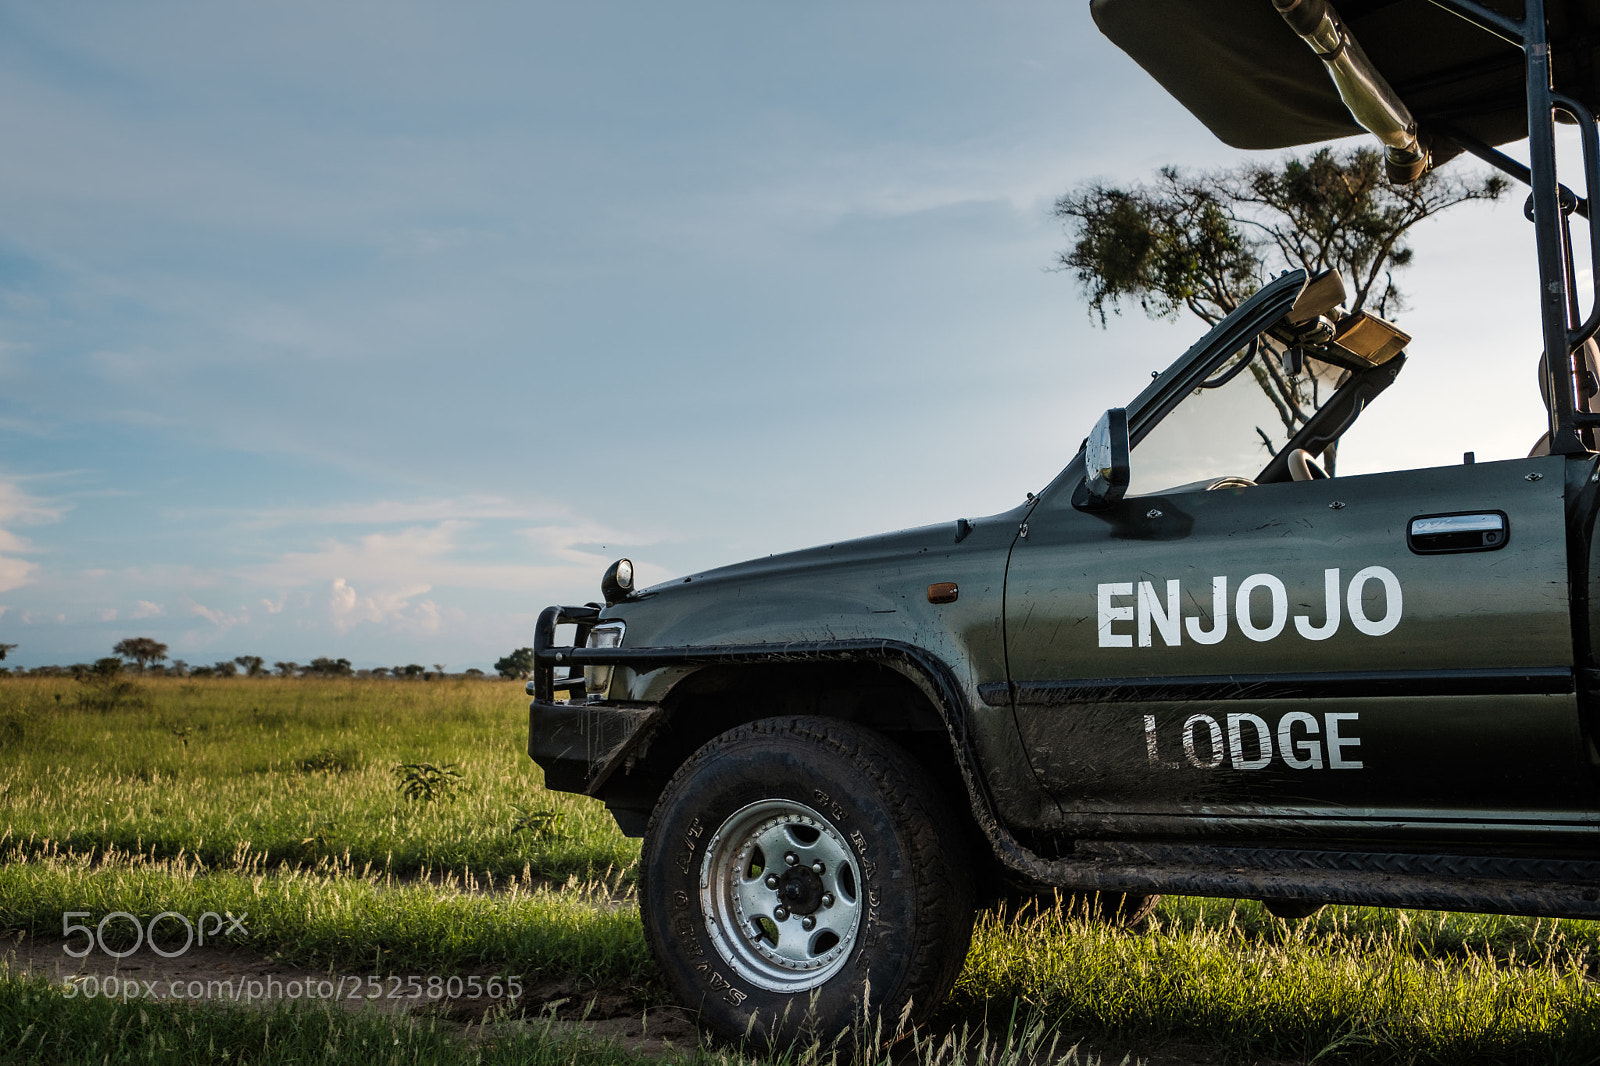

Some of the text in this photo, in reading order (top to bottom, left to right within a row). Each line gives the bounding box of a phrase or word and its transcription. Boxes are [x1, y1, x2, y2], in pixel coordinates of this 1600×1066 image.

[1097, 565, 1403, 648] ENJOJO
[1143, 711, 1364, 770] LODGE
[814, 789, 848, 821] GT
[676, 817, 704, 875] A/T
